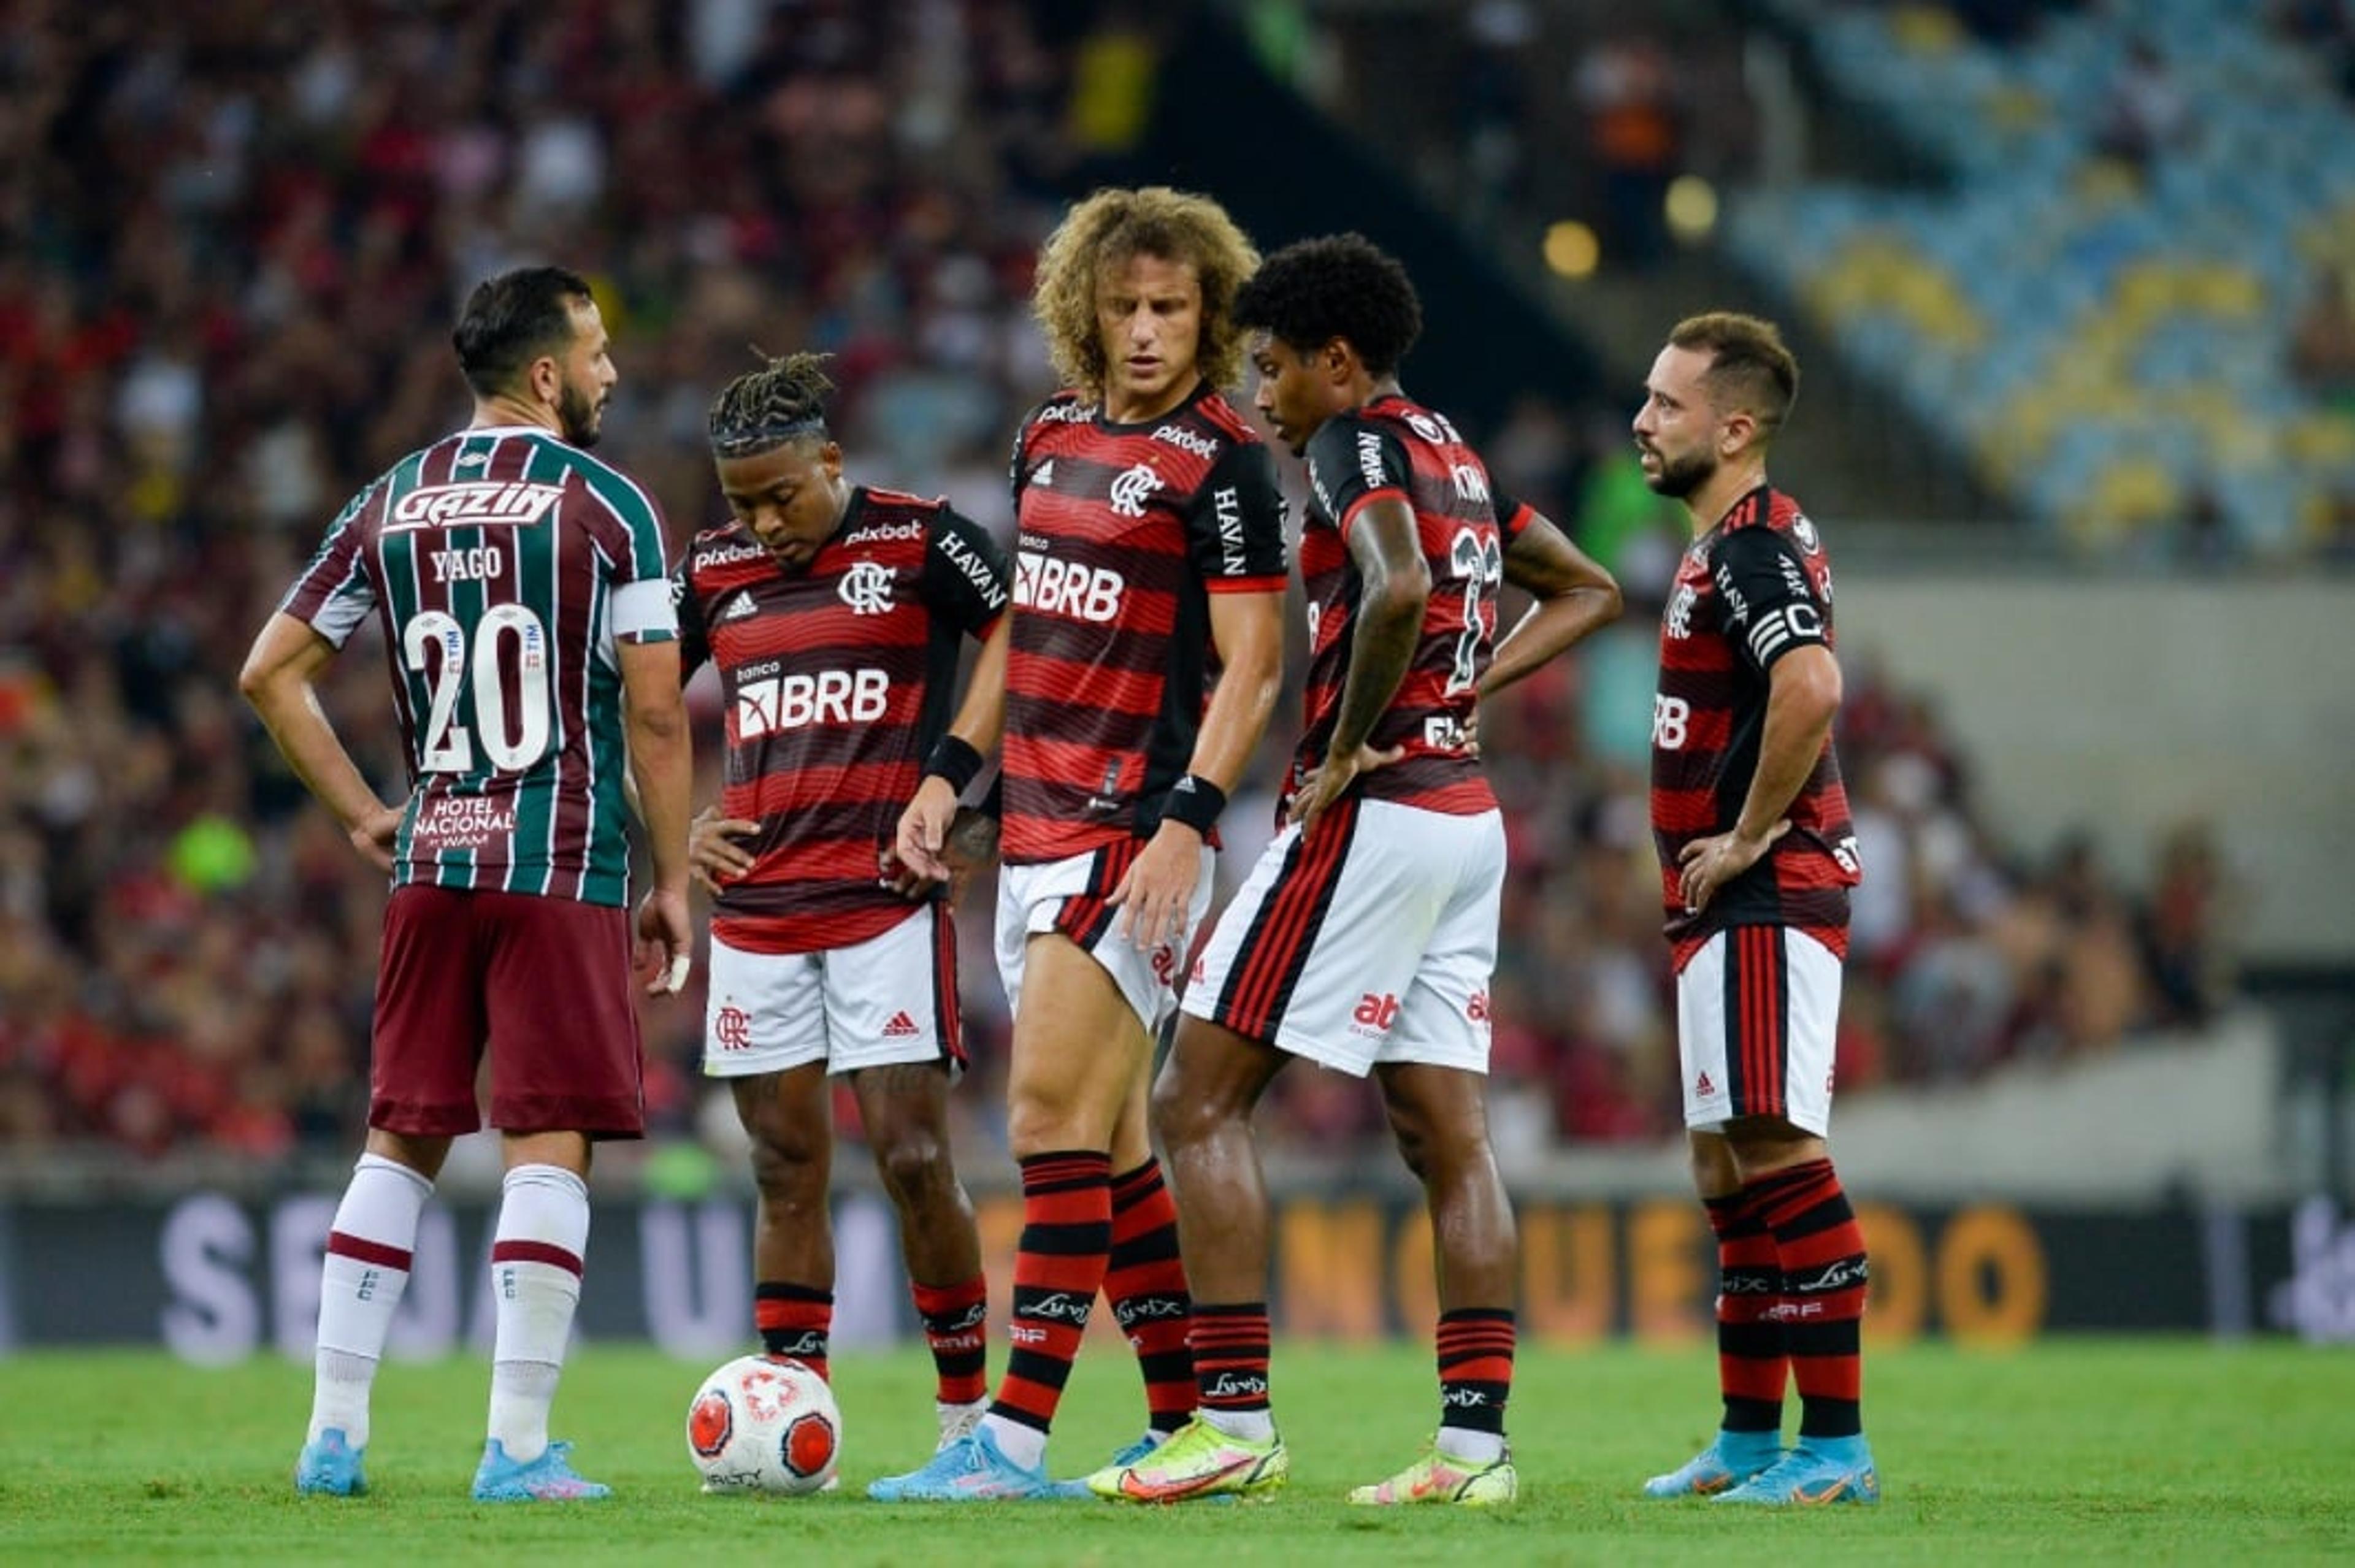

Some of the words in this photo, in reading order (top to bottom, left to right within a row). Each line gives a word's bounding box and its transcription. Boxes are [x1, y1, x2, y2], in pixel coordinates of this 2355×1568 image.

[1149, 424, 1219, 460] pixbet
[388, 482, 564, 529] GAZIN
[844, 518, 922, 548] pixbet
[1214, 486, 1247, 576] HAVAN
[431, 547, 503, 582] YAGO
[695, 542, 765, 573] pixbet
[936, 530, 1008, 611] HAVAN
[1036, 557, 1124, 622] BRB
[404, 603, 551, 773] 20
[780, 668, 889, 728] BRB
[413, 811, 514, 837] NACIONAL
[433, 798, 493, 817] HOTEL
